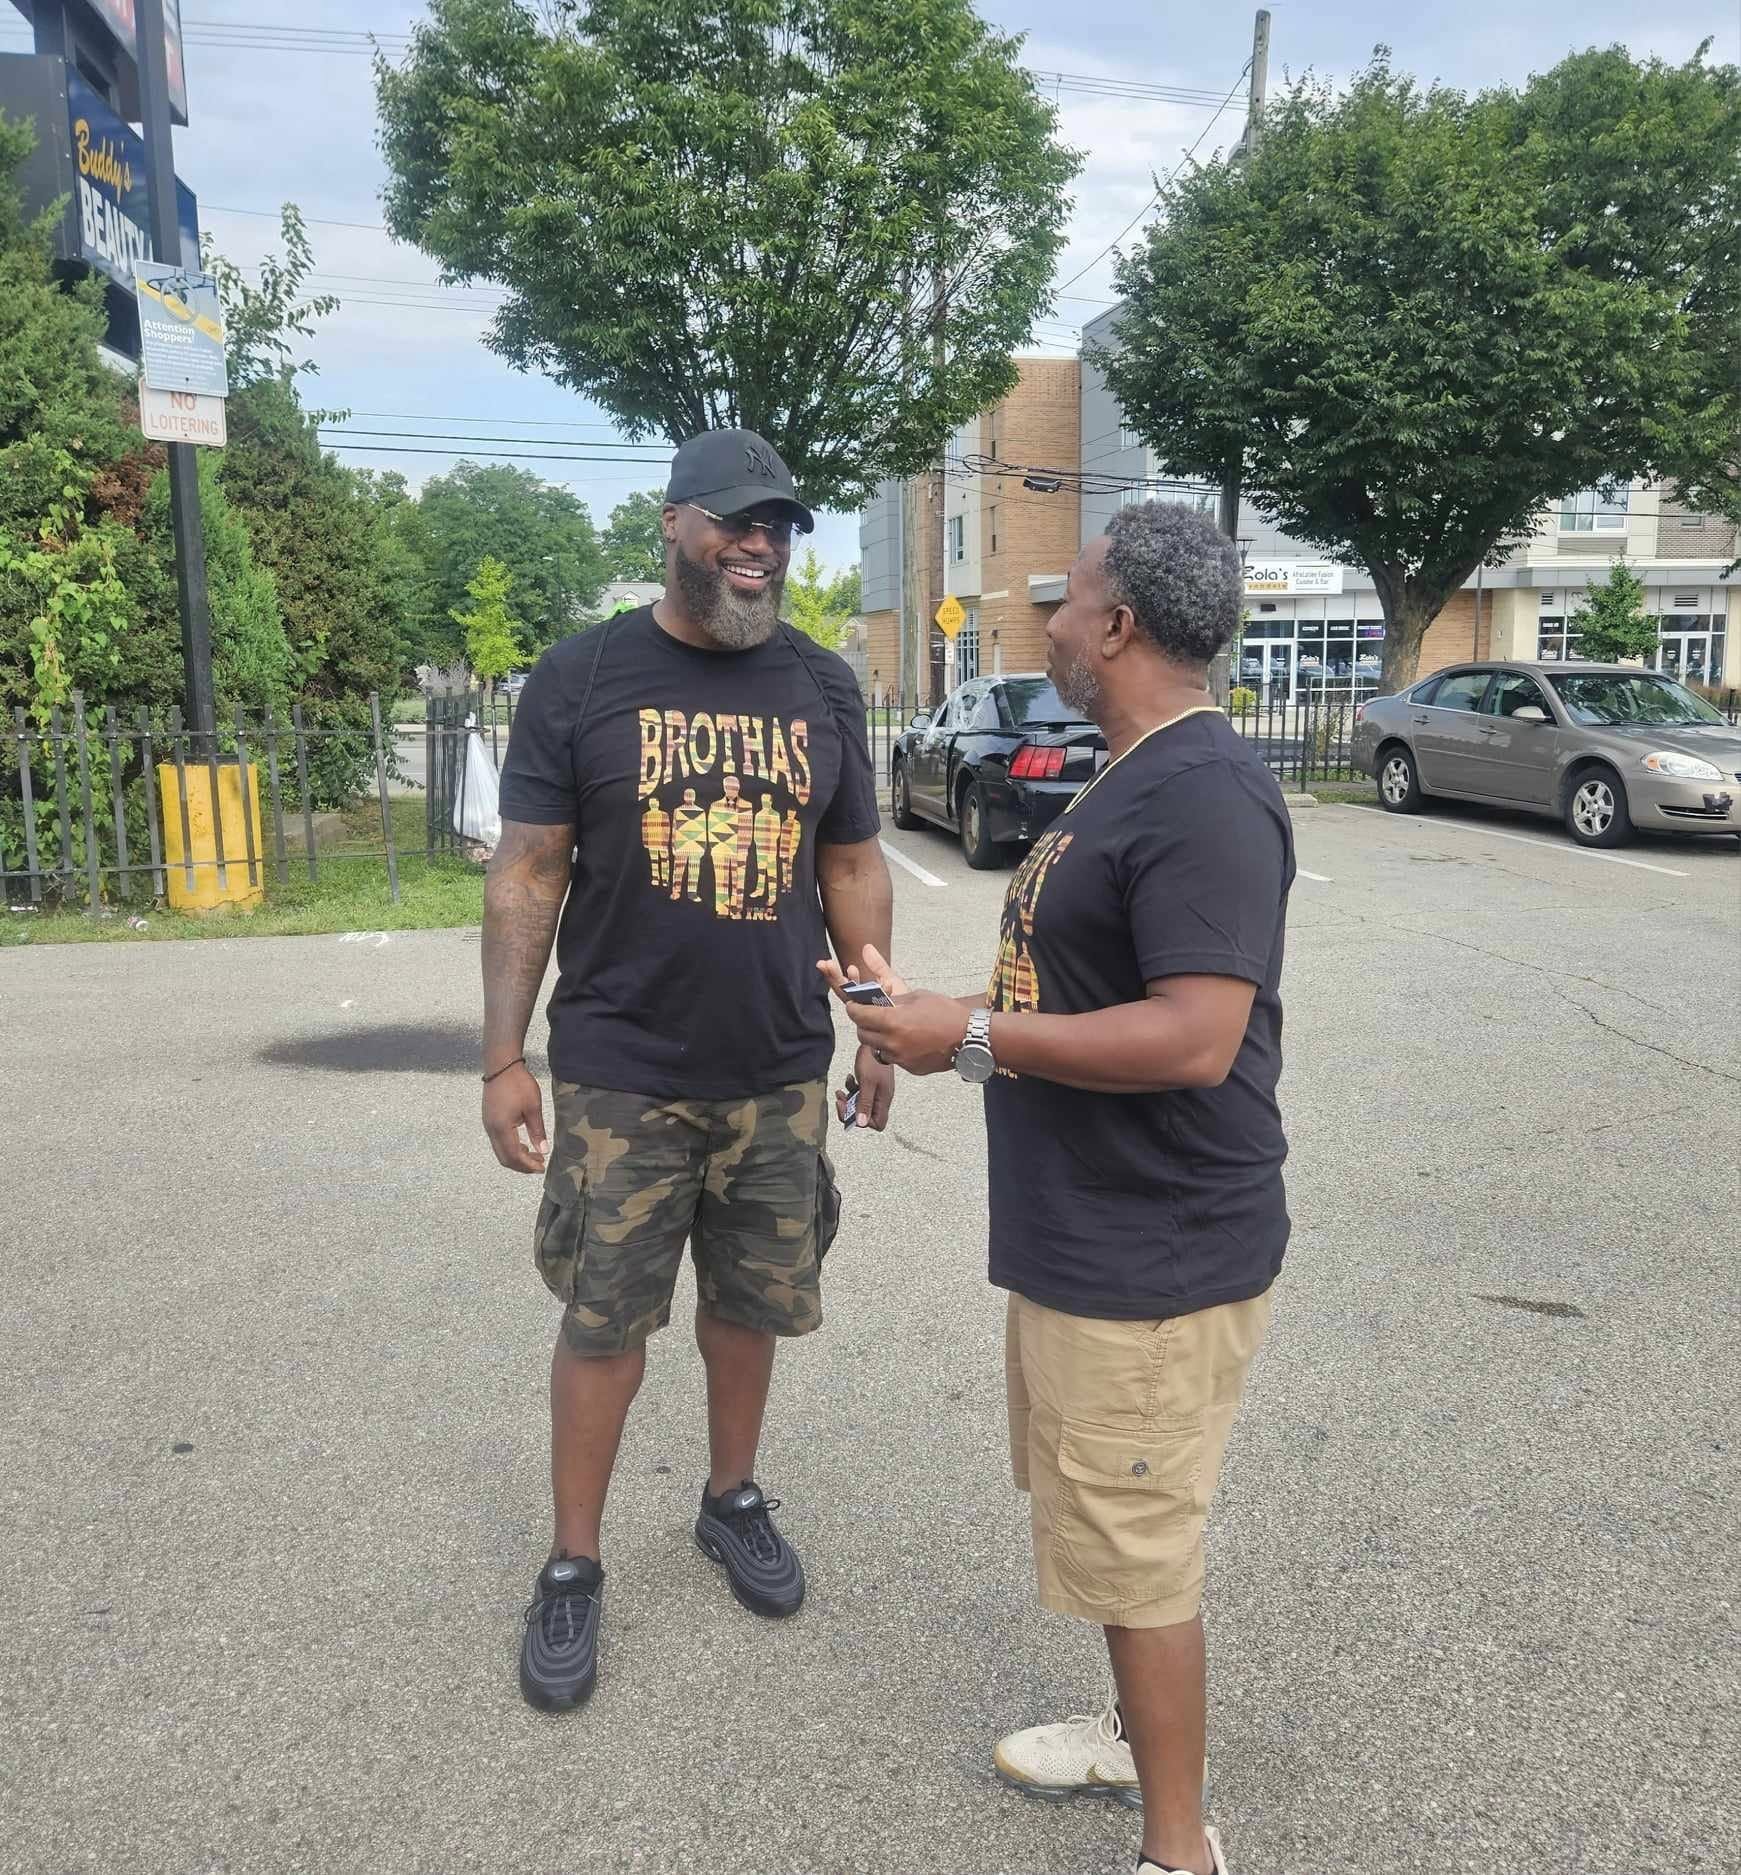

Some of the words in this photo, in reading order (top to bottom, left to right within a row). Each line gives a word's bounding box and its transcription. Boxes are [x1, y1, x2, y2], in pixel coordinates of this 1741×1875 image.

[75, 118, 133, 202] Buddy's
[80, 176, 145, 273] BEAUTY
[143, 320, 195, 335] Attention
[150, 412, 219, 435] LOITERING
[170, 391, 197, 411] NO
[638, 708, 811, 806] BROTHAS
